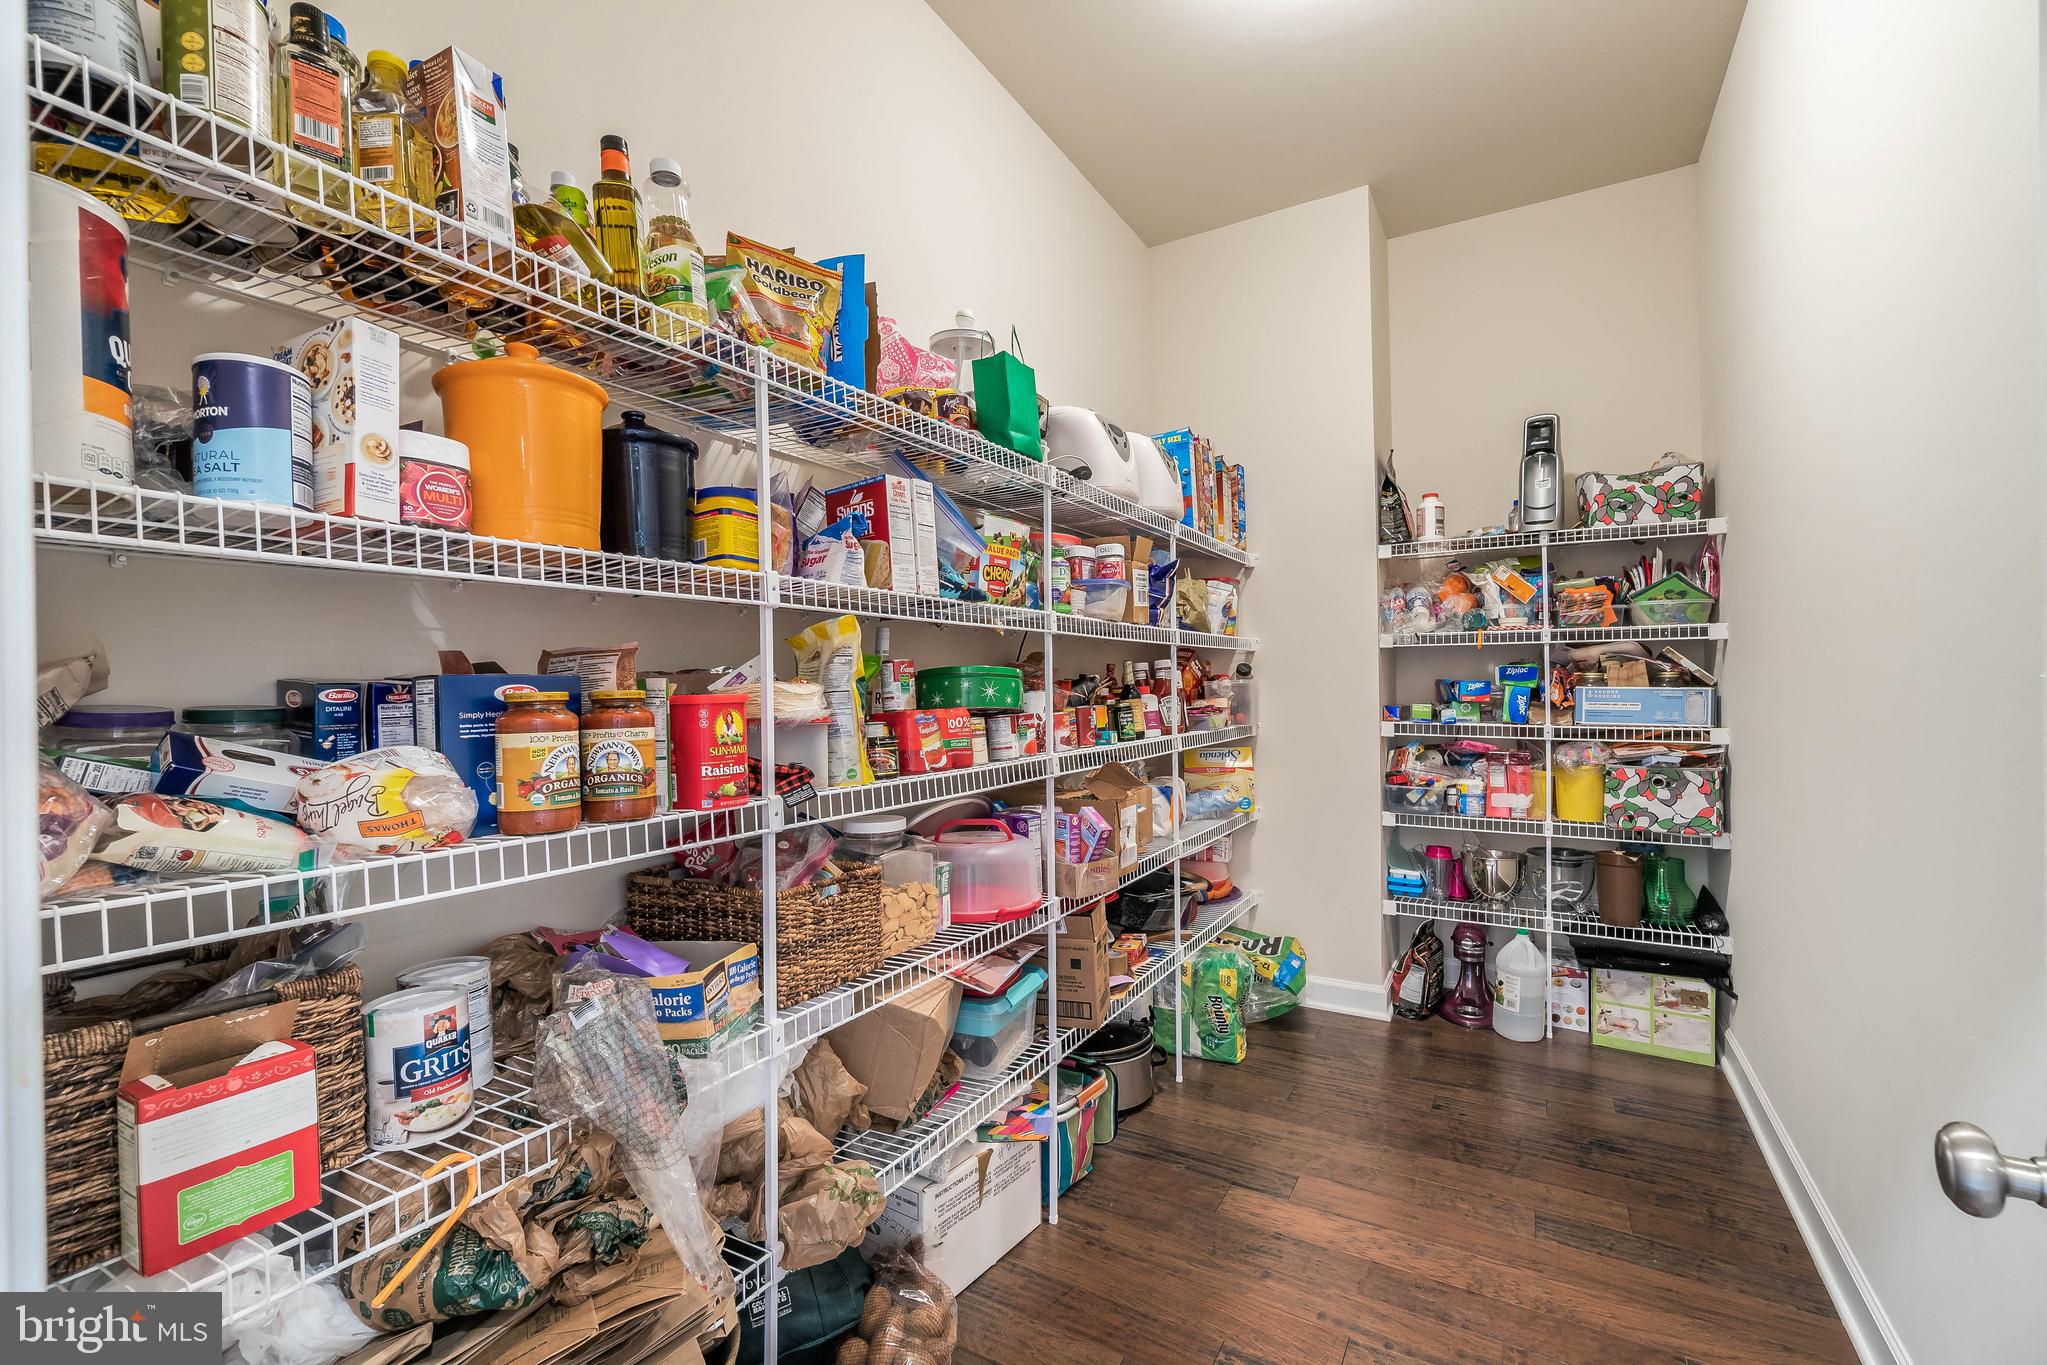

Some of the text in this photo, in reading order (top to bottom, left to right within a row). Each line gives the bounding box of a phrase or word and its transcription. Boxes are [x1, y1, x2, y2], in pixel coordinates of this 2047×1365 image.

[649, 252, 677, 268] esson
[746, 257, 824, 292] HARIBO
[753, 275, 818, 303] Goldbears
[193, 406, 228, 420] ORTON
[1168, 435, 1182, 443] SIZE
[205, 462, 240, 473] SALT
[423, 491, 463, 506] MULTI
[1505, 667, 1529, 675] Ziploc
[1467, 682, 1486, 691] Ziploc
[328, 691, 355, 699] Barilla
[1517, 694, 1527, 716] Ziploc
[947, 717, 971, 728] 100%
[592, 731, 617, 739] Profits
[531, 747, 546, 755] NON
[531, 752, 547, 760] GMO
[588, 741, 625, 767] NEWMAN'S
[709, 745, 747, 756] SUN-MAID
[1200, 750, 1241, 763] Splenda
[701, 763, 745, 777] Raisins
[587, 773, 643, 786] ORGANICS
[594, 786, 615, 795] Tomato
[620, 784, 634, 793] Basil
[737, 960, 756, 973] Calorie
[652, 993, 692, 1005] alorie
[665, 1008, 693, 1017] Packs
[1207, 995, 1230, 1035] Bounty
[425, 1031, 457, 1048] QUAKER
[400, 1039, 470, 1083] GRITS
[423, 1078, 463, 1096] Old Fashioned
[934, 1176, 964, 1200] INSTRUCTIONS
